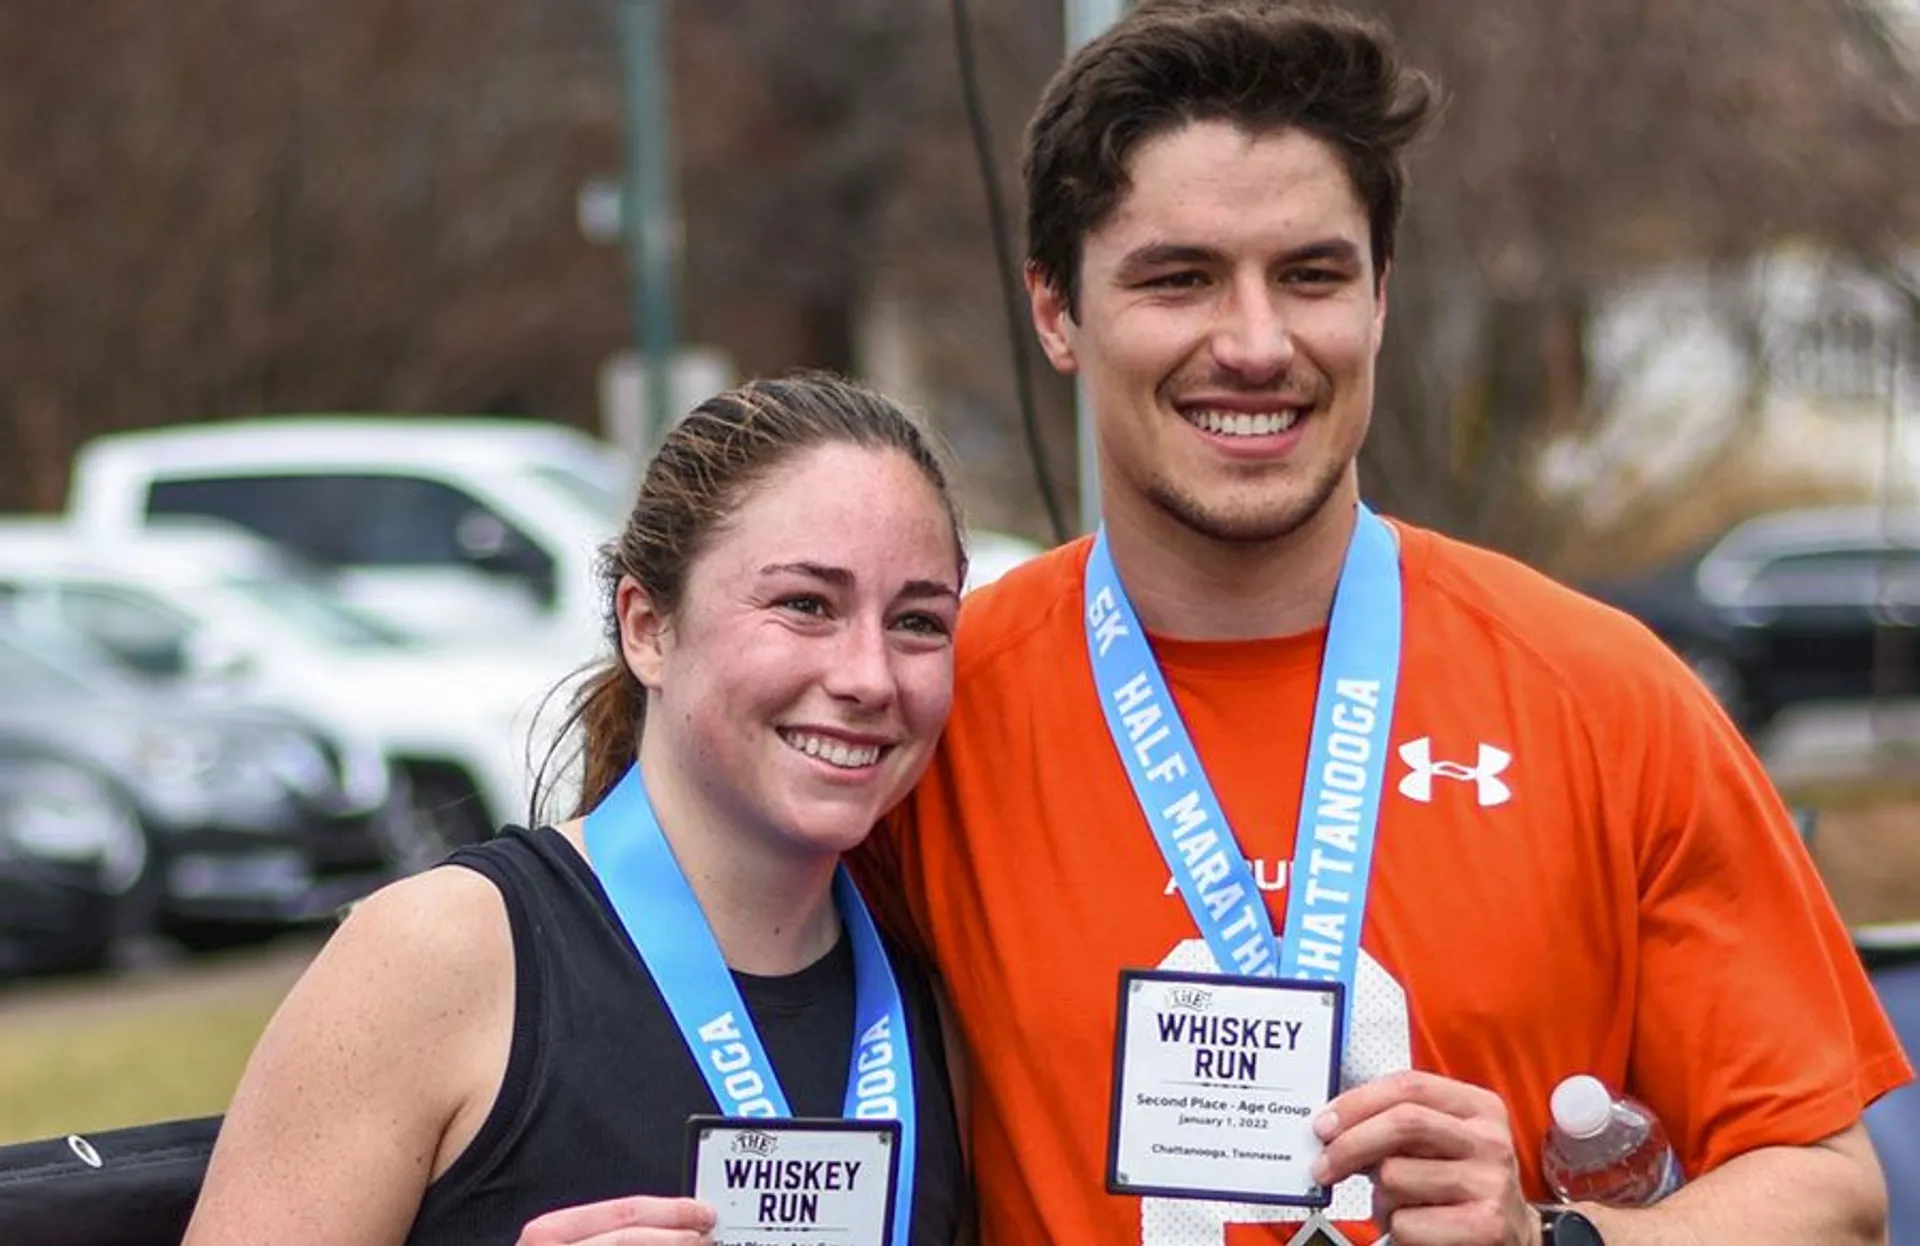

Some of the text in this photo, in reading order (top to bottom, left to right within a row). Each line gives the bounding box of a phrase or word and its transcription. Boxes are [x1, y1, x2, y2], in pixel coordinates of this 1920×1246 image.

[1088, 584, 1130, 658] 5K
[1113, 670, 1189, 784] HALF
[1295, 677, 1381, 981] HATTANOOGA
[1157, 1012, 1303, 1050] WHISKEY
[1194, 1049, 1257, 1081] RUN
[1136, 1093, 1188, 1108] Second
[1190, 1096, 1228, 1111] Place
[1236, 1101, 1266, 1115] Age
[1268, 1102, 1312, 1118] Group
[1178, 1113, 1223, 1127] January
[1239, 1117, 1268, 1129] 2022
[736, 1133, 771, 1153] THE
[1232, 1149, 1292, 1162] Tennessee
[724, 1158, 861, 1191] WHISKEY
[758, 1193, 818, 1223] RUN
